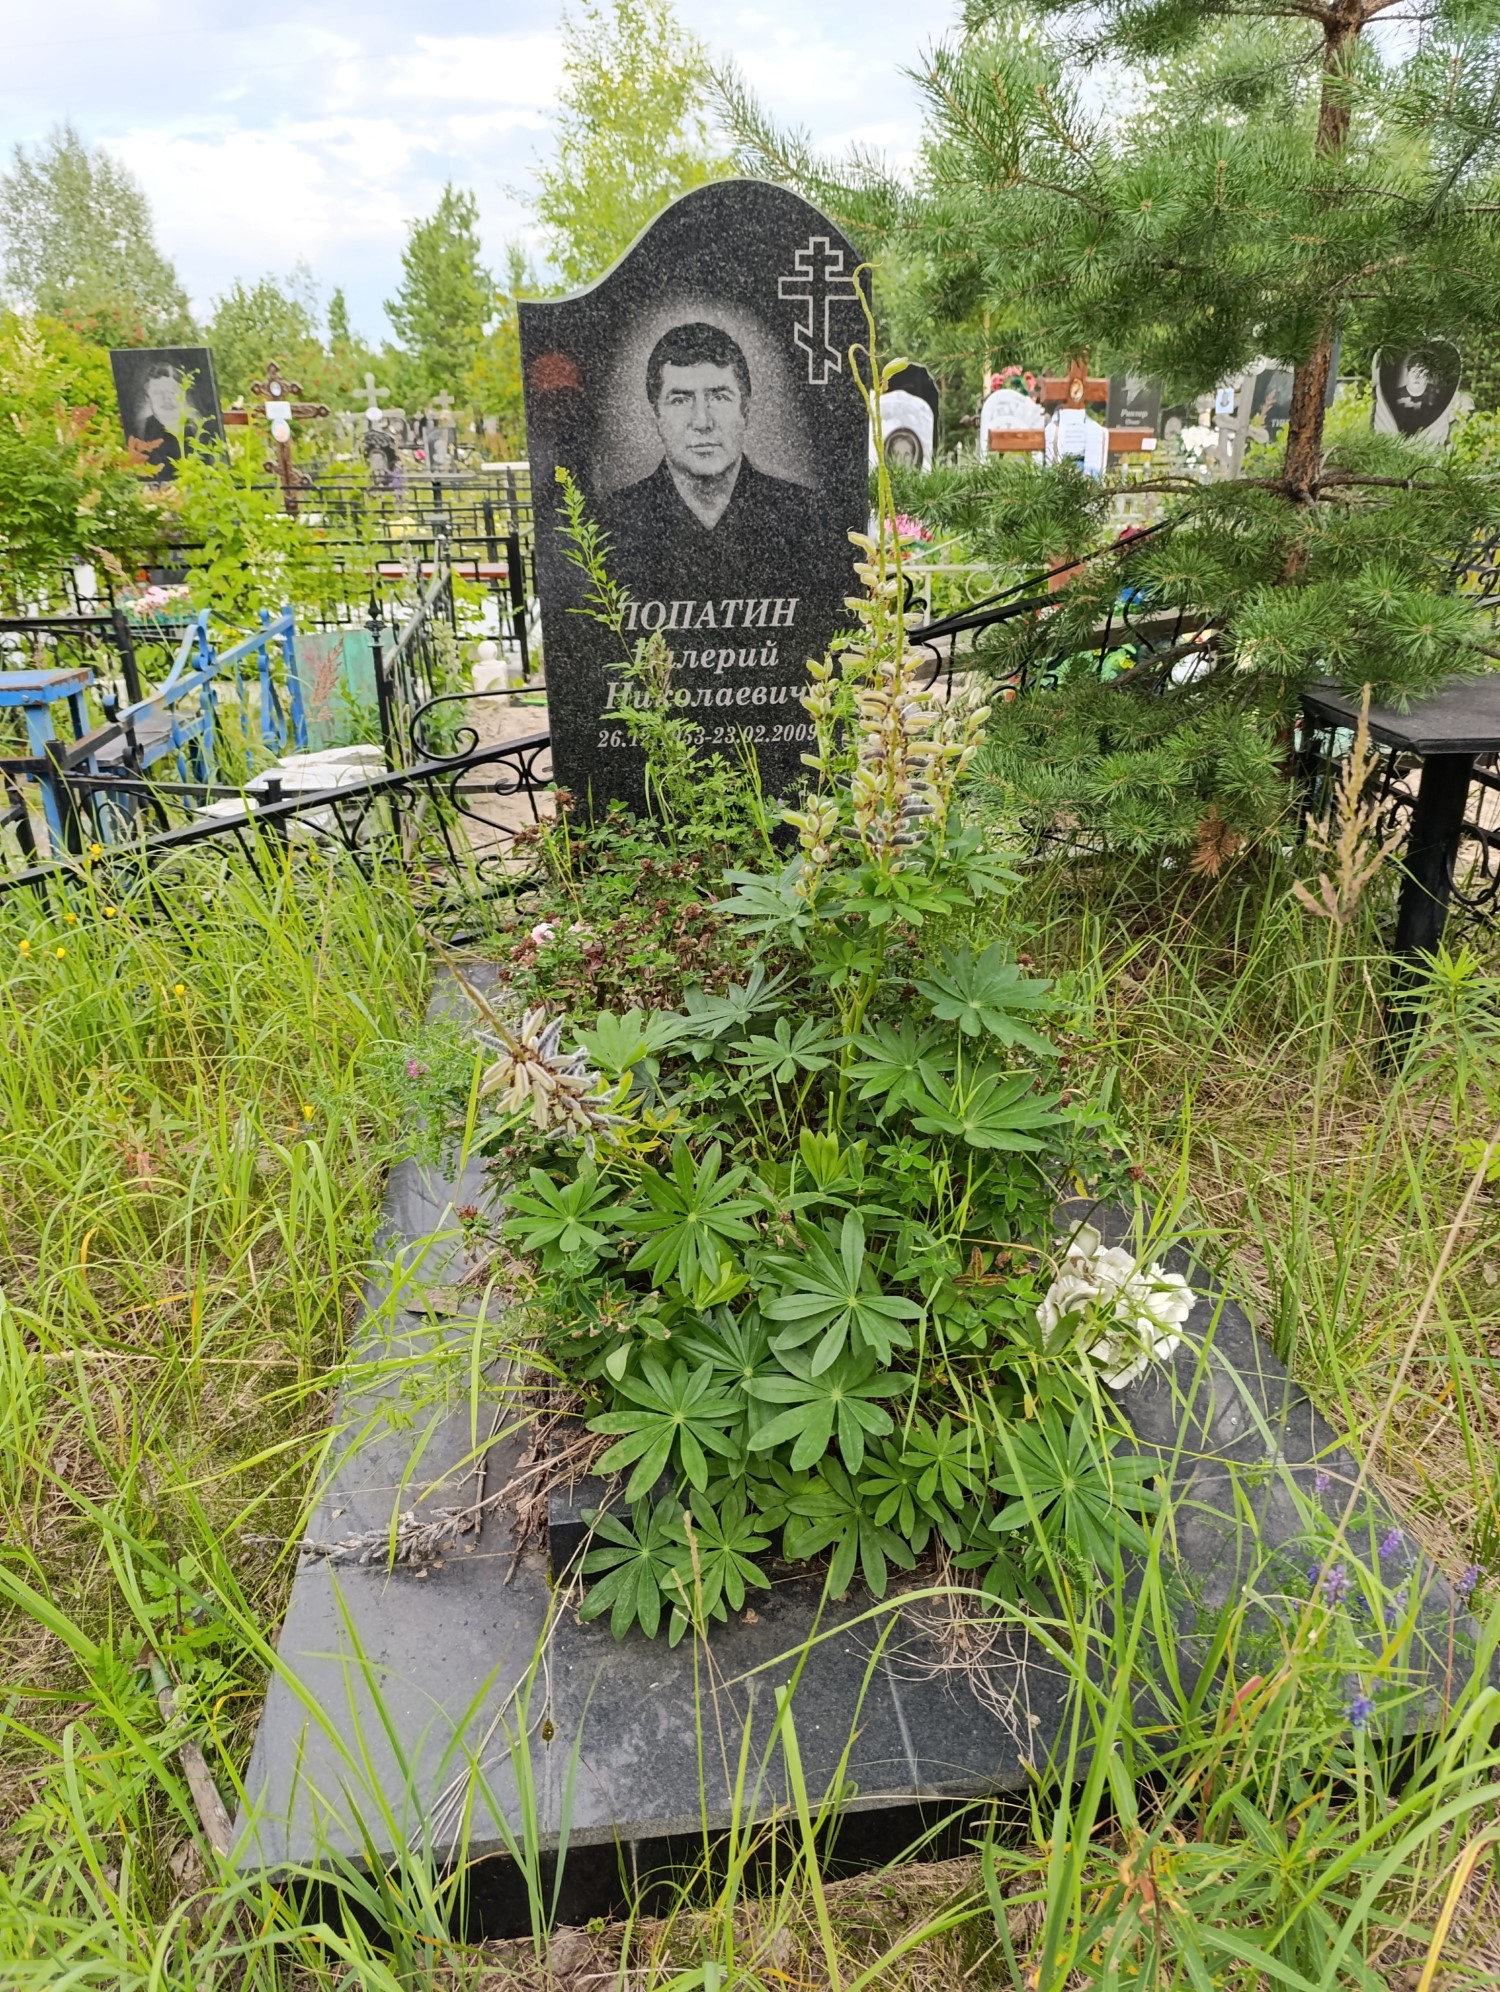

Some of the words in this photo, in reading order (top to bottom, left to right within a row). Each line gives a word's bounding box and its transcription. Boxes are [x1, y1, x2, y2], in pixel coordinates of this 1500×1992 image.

[610, 598, 799, 631] ЛОПАТИН
[630, 639, 779, 674] лерий
[597, 722, 817, 749] 26.153-23.02.2009
